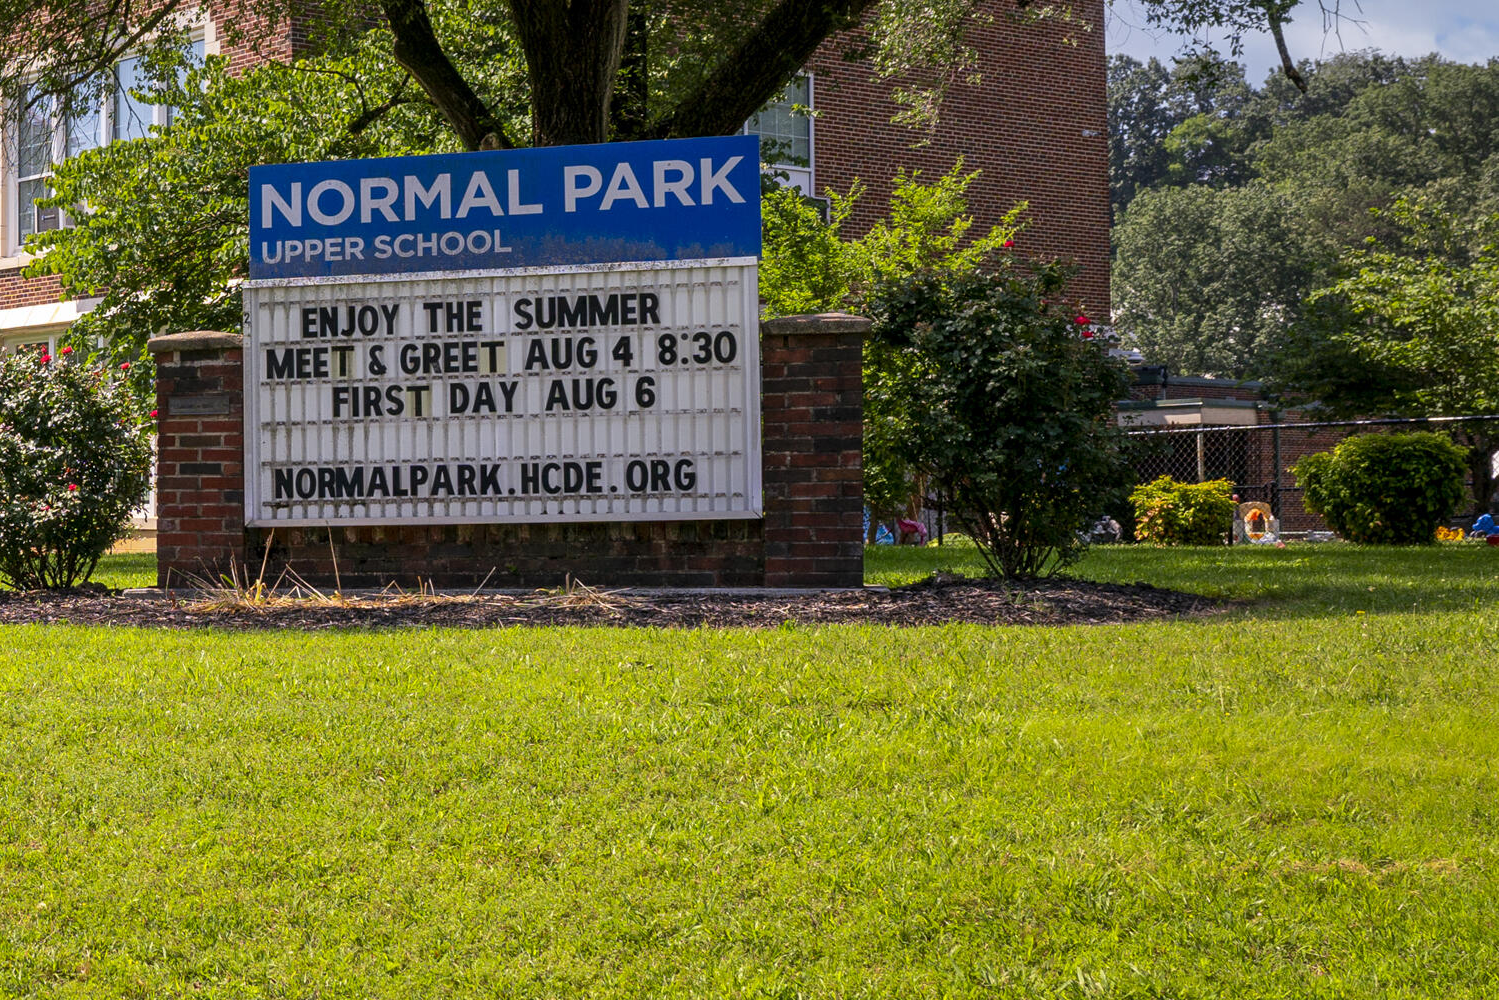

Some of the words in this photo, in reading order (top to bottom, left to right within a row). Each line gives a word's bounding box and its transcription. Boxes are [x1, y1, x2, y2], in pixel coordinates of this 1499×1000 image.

[262, 170, 542, 228] NORMAL
[565, 156, 745, 212] PARK
[263, 238, 364, 264] UPPER
[375, 230, 511, 258] SCHOOL
[302, 304, 399, 338] ENJOY
[424, 301, 482, 332] THE
[514, 293, 660, 329] SUMMER
[267, 346, 354, 379] MEET
[369, 345, 386, 375] &
[401, 341, 504, 374] GREET
[525, 337, 597, 370] AUG
[613, 336, 633, 367] 4
[658, 331, 737, 365] 8:30
[333, 385, 429, 417] FIRST
[450, 381, 518, 413] DAY
[546, 378, 617, 411] AUG
[636, 376, 655, 408] 6
[275, 459, 696, 499] NORMALPARK.HCDE.ORG
